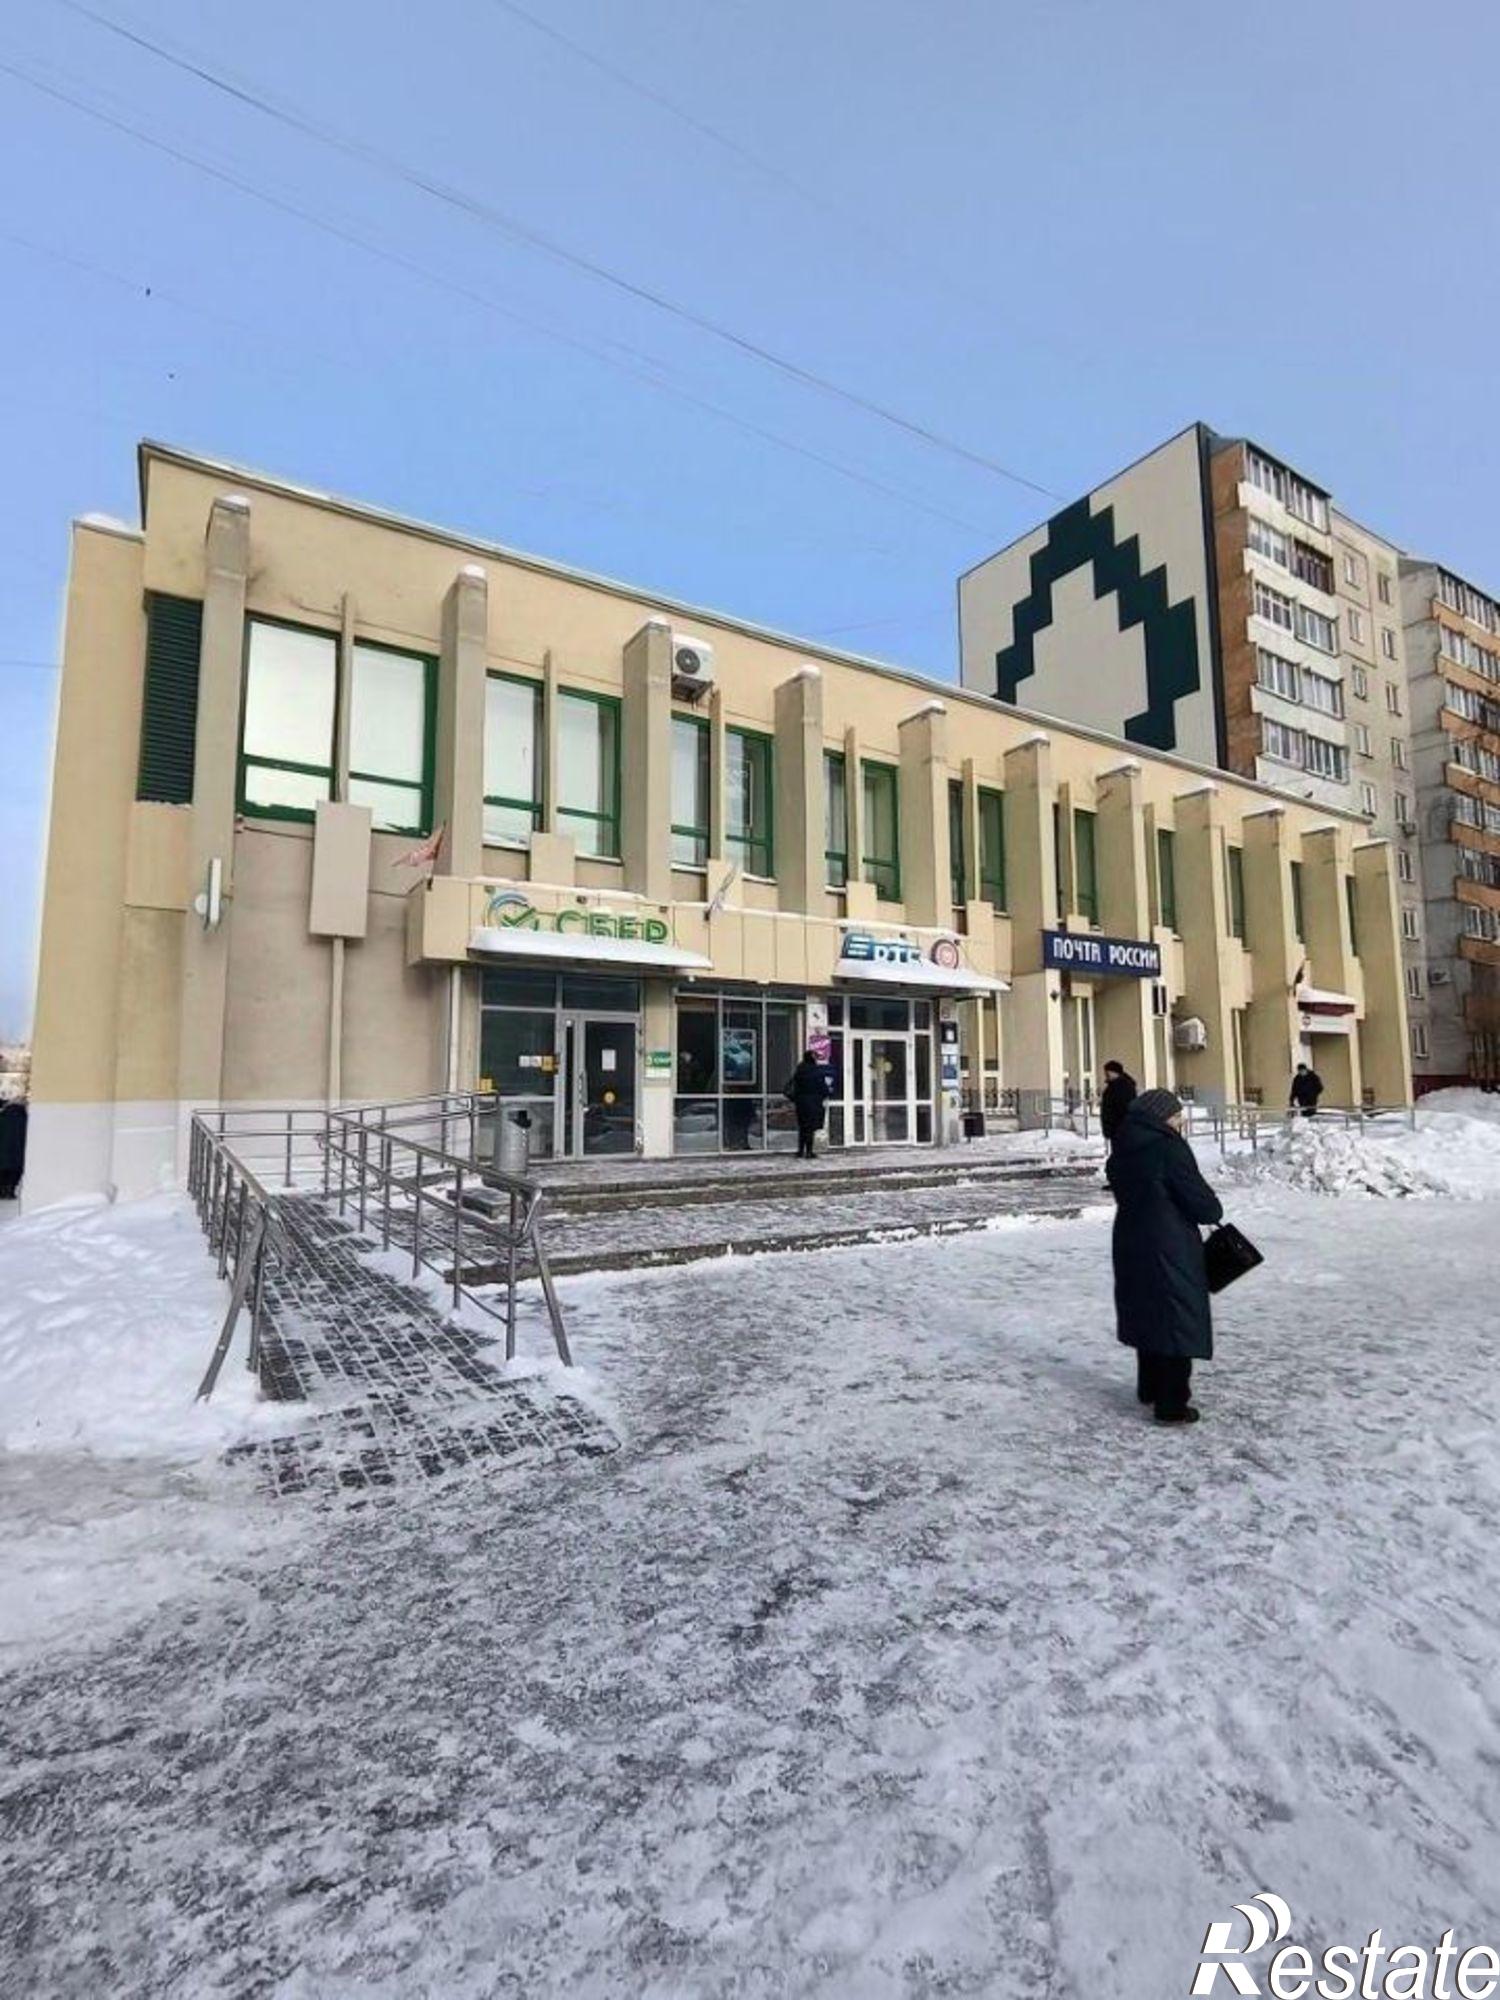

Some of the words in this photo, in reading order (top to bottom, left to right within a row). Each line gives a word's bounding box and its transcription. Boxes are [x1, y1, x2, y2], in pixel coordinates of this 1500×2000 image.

[556, 909, 668, 944] СБЕР
[1053, 937, 1101, 963] ПОЧТА
[1109, 944, 1159, 969] РОССИИ
